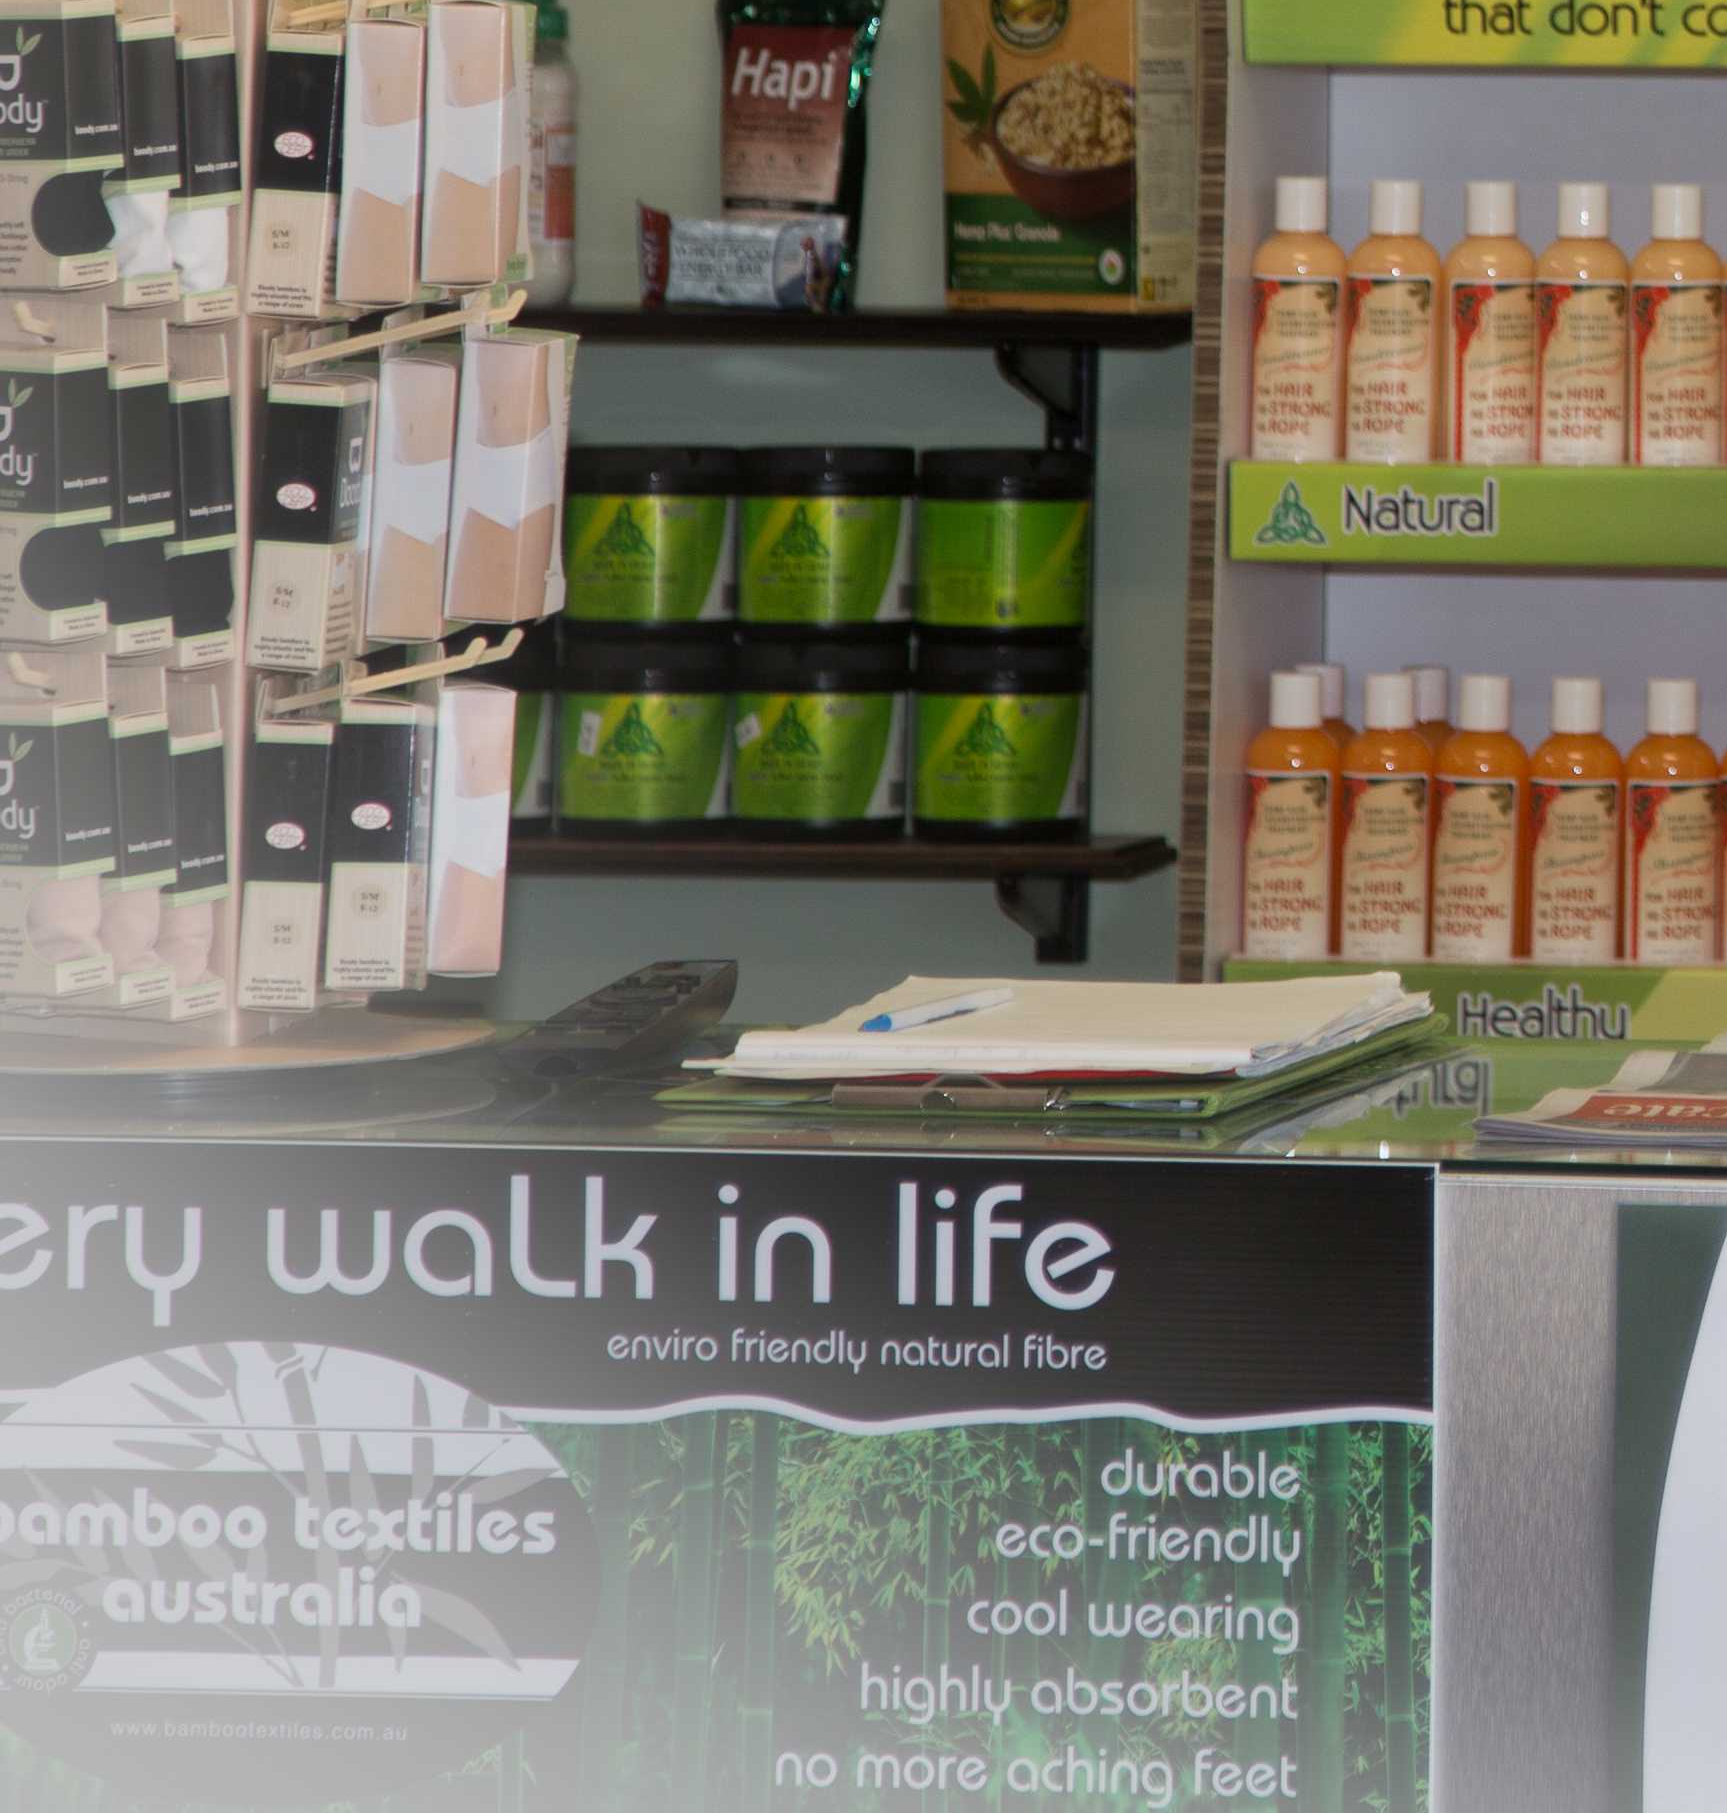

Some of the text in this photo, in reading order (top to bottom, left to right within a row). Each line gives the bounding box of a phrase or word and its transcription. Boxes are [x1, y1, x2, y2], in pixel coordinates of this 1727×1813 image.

[732, 48, 839, 109] Hapi
[1344, 481, 1495, 533] Natural
[267, 1174, 658, 1300] walk
[717, 1182, 832, 1306] in
[896, 1181, 1117, 1311] life
[606, 1329, 1107, 1373] enviro friendly natural fibre
[1100, 1449, 1301, 1502] durable
[0, 1488, 557, 1555] amboo textiles
[995, 1513, 1301, 1576] eco-friendly
[103, 1567, 421, 1628] australia
[966, 1590, 1301, 1656] cool wearing
[859, 1663, 1298, 1724] highly absorbent
[775, 1745, 1297, 1807] no more aching feet
